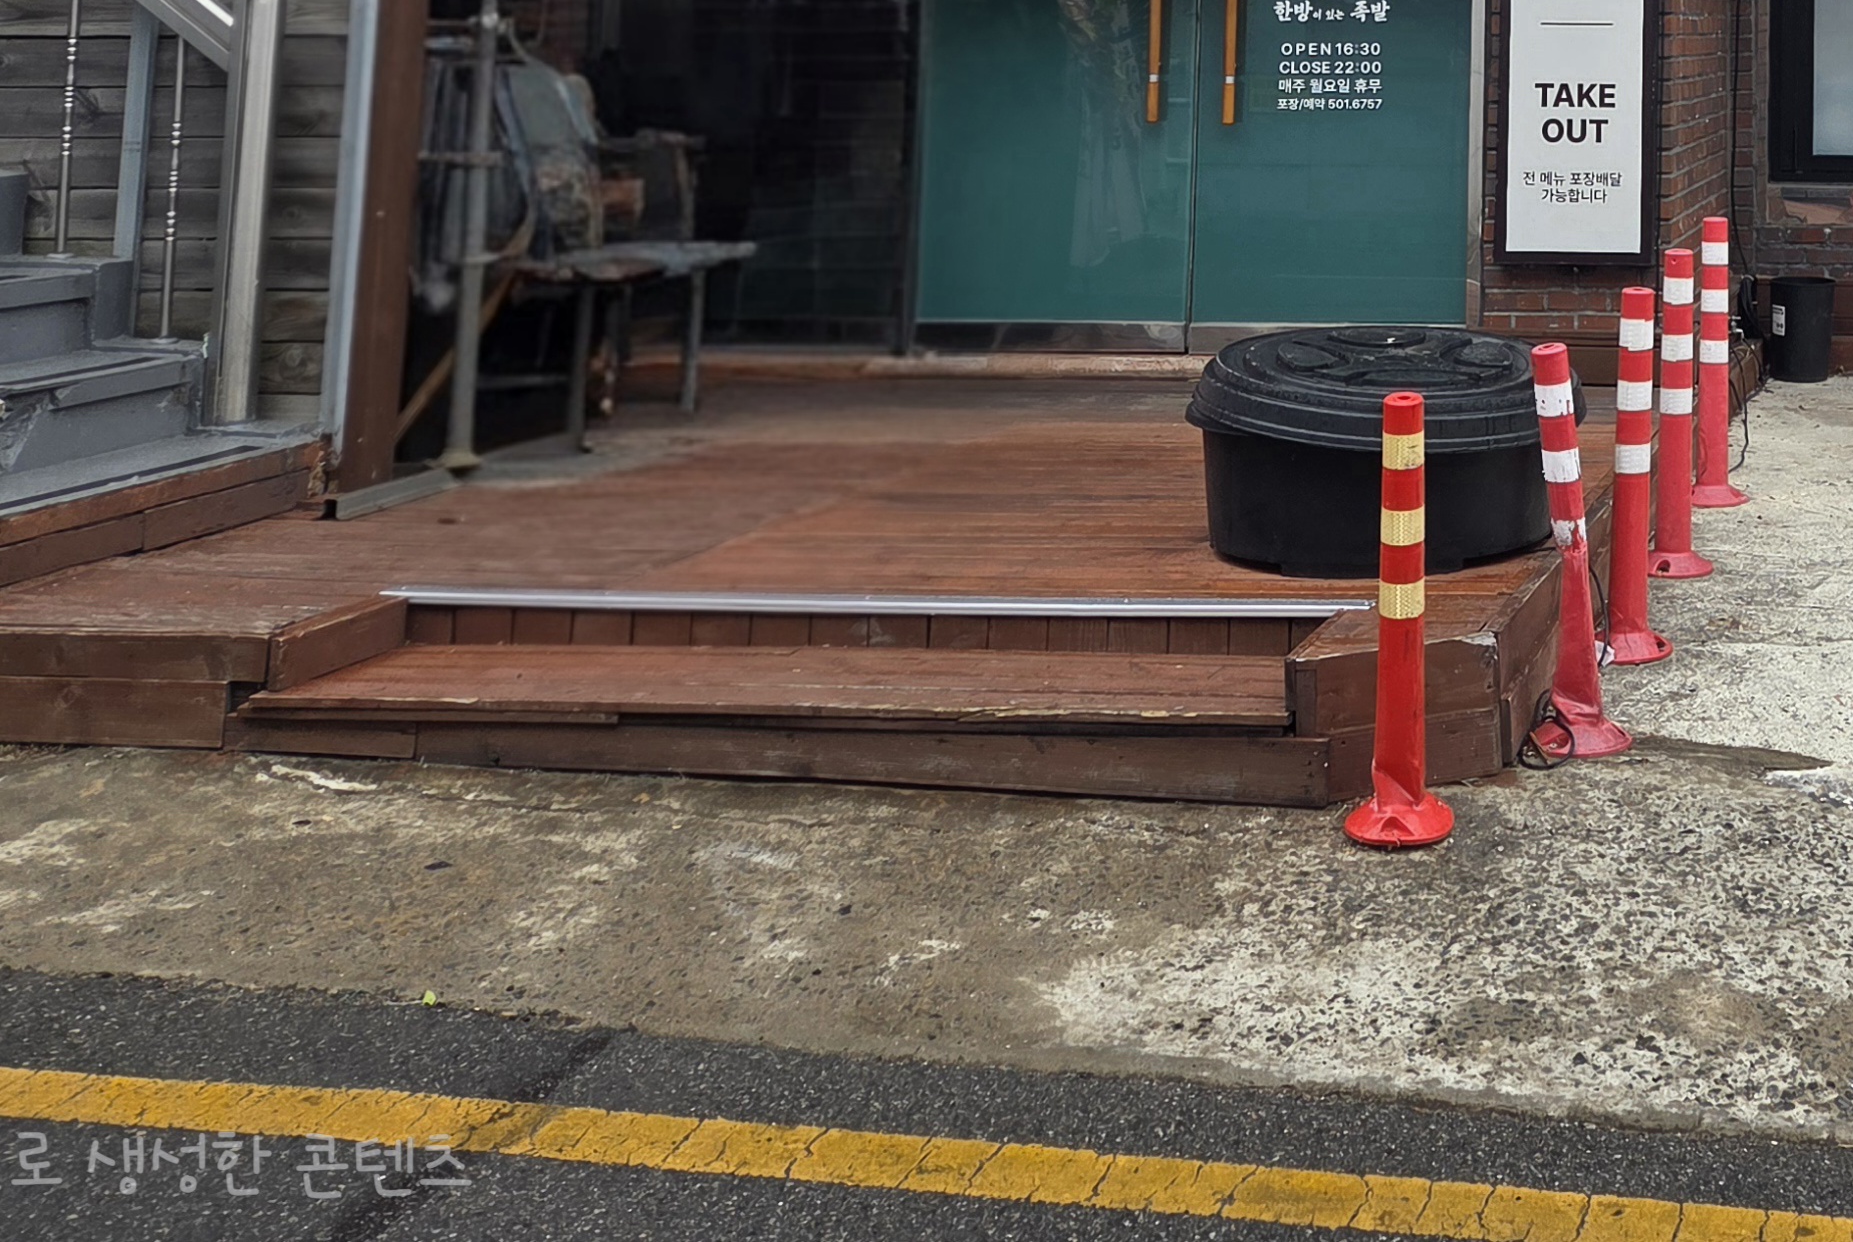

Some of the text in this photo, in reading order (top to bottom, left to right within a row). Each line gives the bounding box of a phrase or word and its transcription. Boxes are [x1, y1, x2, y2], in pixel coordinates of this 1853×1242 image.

[1273, 0, 1391, 23] 한방이 있는 족발
[1280, 43, 1381, 56] OPEN 16:30
[1279, 61, 1382, 74] CLOSE 22:00
[1278, 78, 1383, 94] 매주 월요일 휴무
[1534, 82, 1616, 108] TAKE
[1277, 98, 1382, 111] 포장/예약 501.6757
[1541, 118, 1609, 144] OUT
[1523, 171, 1622, 187] 전 메뉴 포장배달
[1541, 188, 1608, 204] 가능합니다
